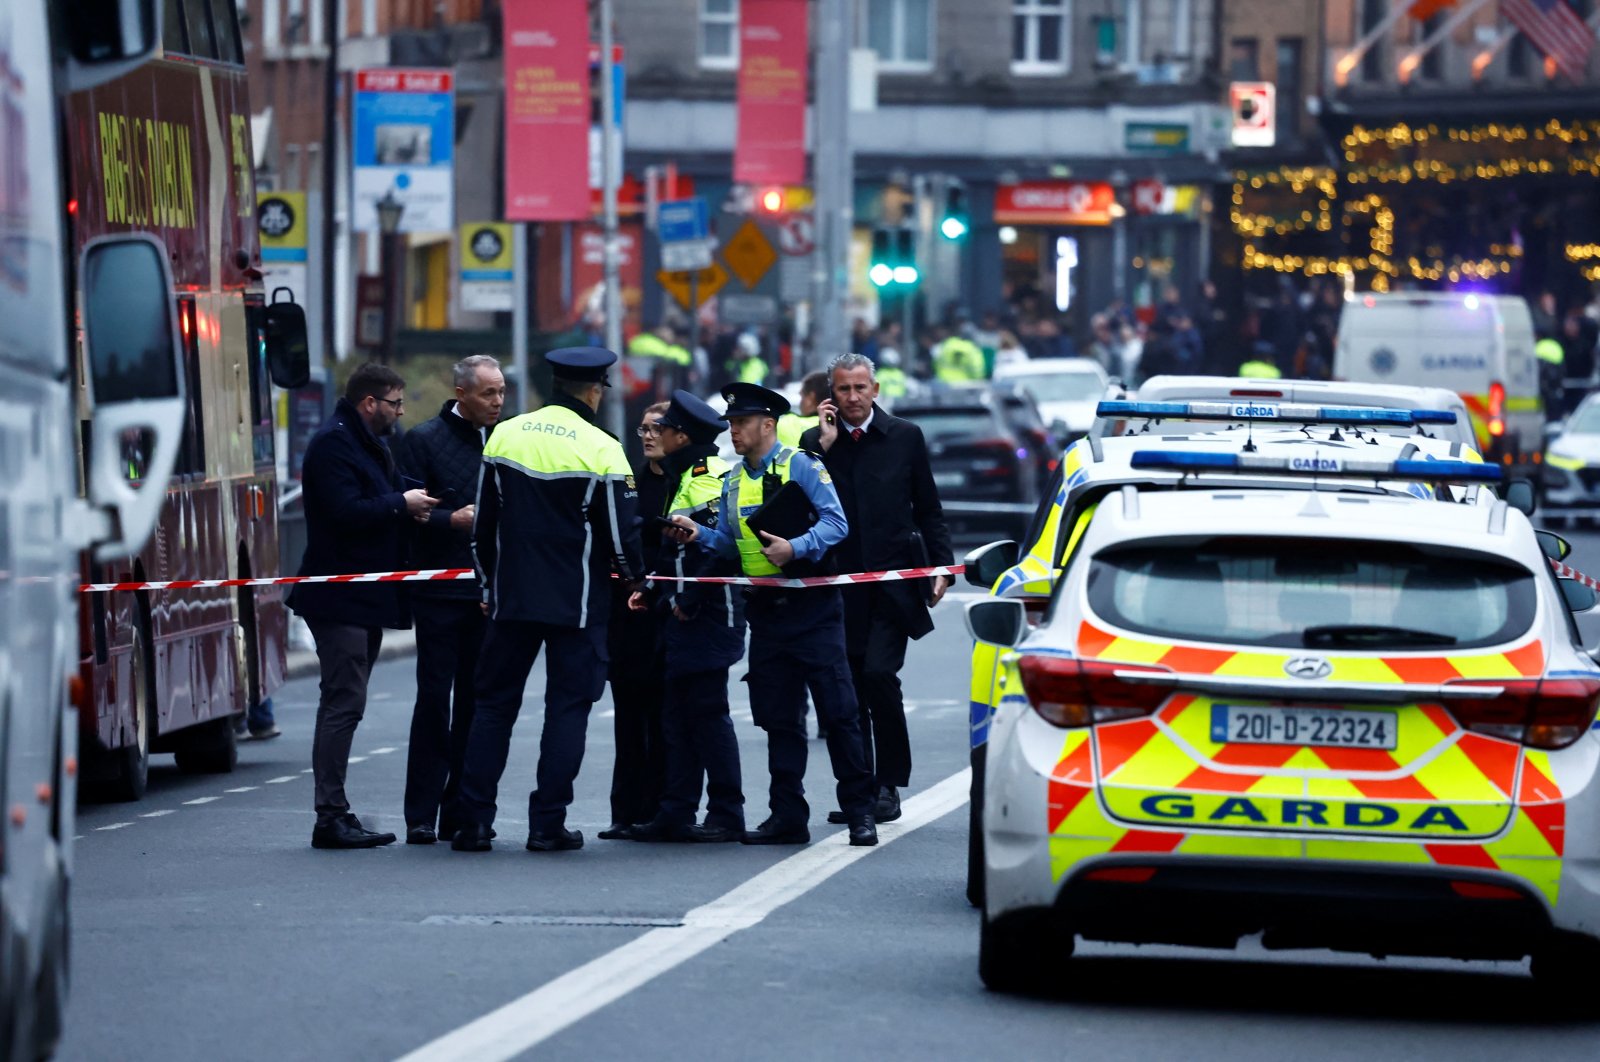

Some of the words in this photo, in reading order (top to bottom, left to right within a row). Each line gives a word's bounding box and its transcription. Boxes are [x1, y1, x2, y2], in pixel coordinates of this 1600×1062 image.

[146, 119, 195, 229] DUBLIN
[1422, 353, 1485, 370] GARDA
[1235, 406, 1275, 417] GARDA
[521, 421, 578, 441] GARDA
[1293, 458, 1338, 471] GARDA
[1236, 714, 1387, 745] 201-D-22324
[1140, 794, 1470, 832] GARDA
